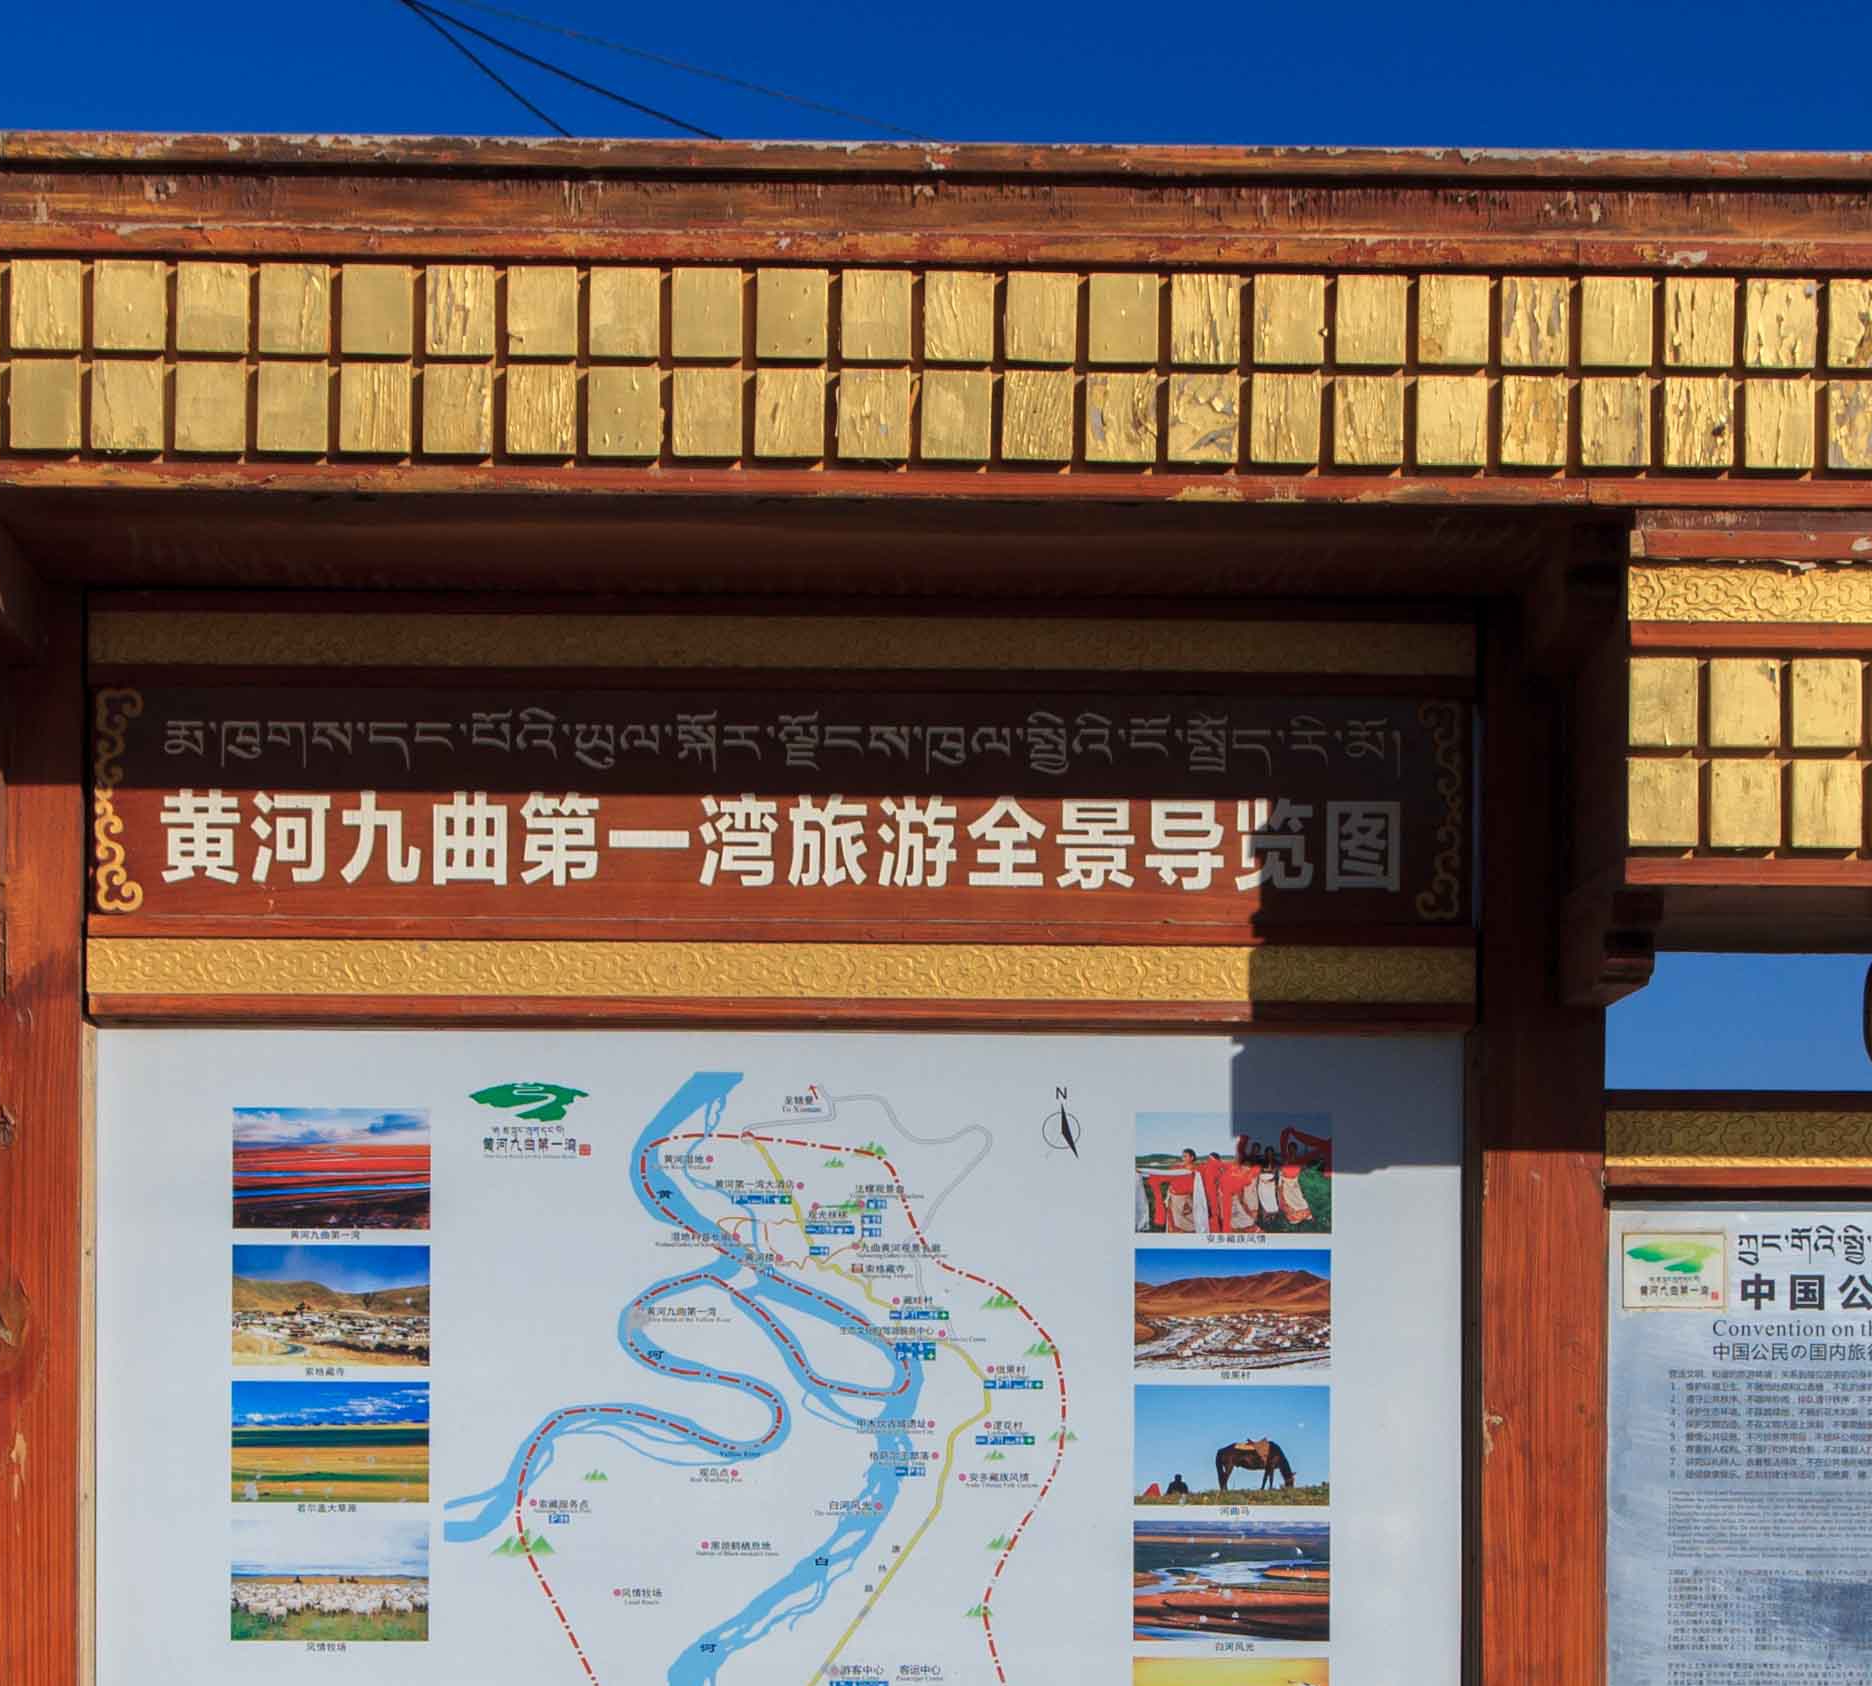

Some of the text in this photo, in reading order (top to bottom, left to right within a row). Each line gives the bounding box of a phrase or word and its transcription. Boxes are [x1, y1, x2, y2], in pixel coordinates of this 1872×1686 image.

[159, 788, 1402, 892] 黄河九曲第一湾旅游全景导览图
[1056, 1087, 1067, 1100] N
[1713, 1320, 1826, 1337] Convention
[1832, 1326, 1856, 1337] on
